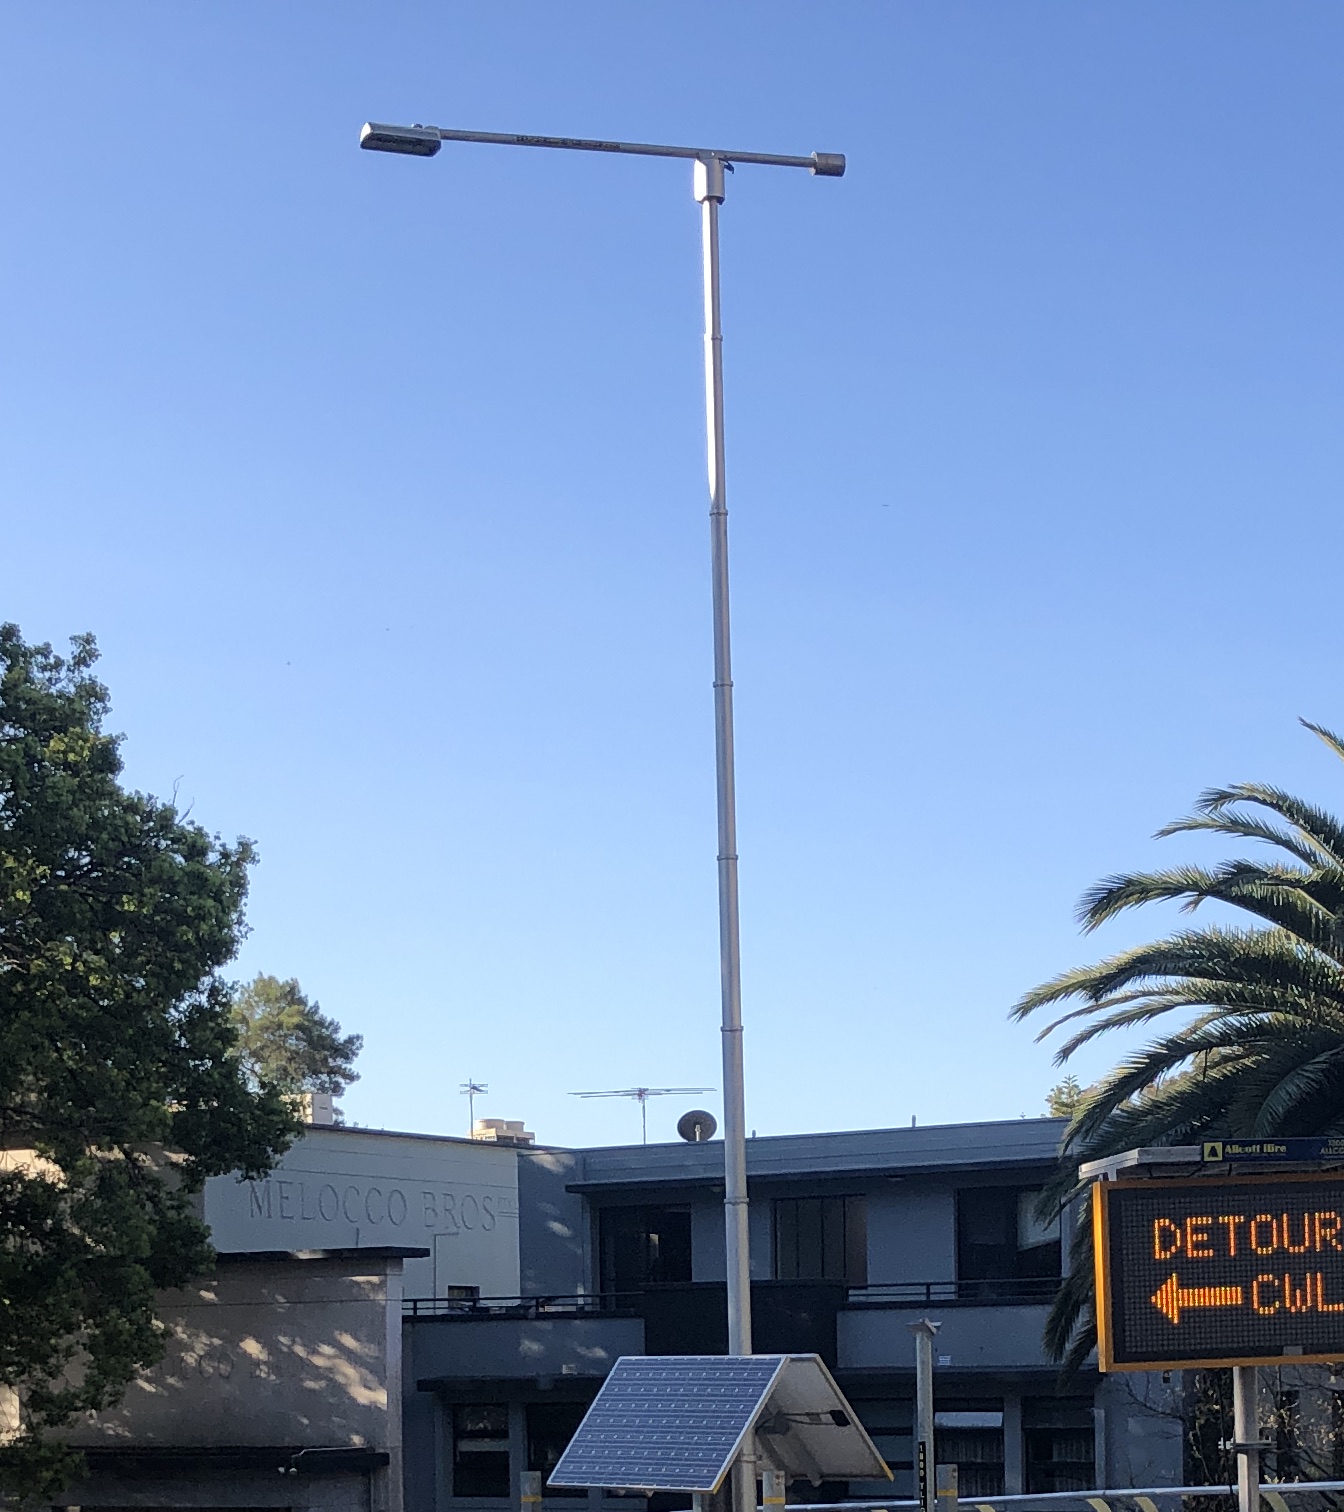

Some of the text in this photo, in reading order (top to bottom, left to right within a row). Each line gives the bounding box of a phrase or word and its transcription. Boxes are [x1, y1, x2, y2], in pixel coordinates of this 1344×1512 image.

[249, 1180, 407, 1226] MELOCCO
[422, 1191, 497, 1232] BROS
[1153, 1211, 1343, 1260] DETOUR
[1252, 1272, 1344, 1315] CWL
